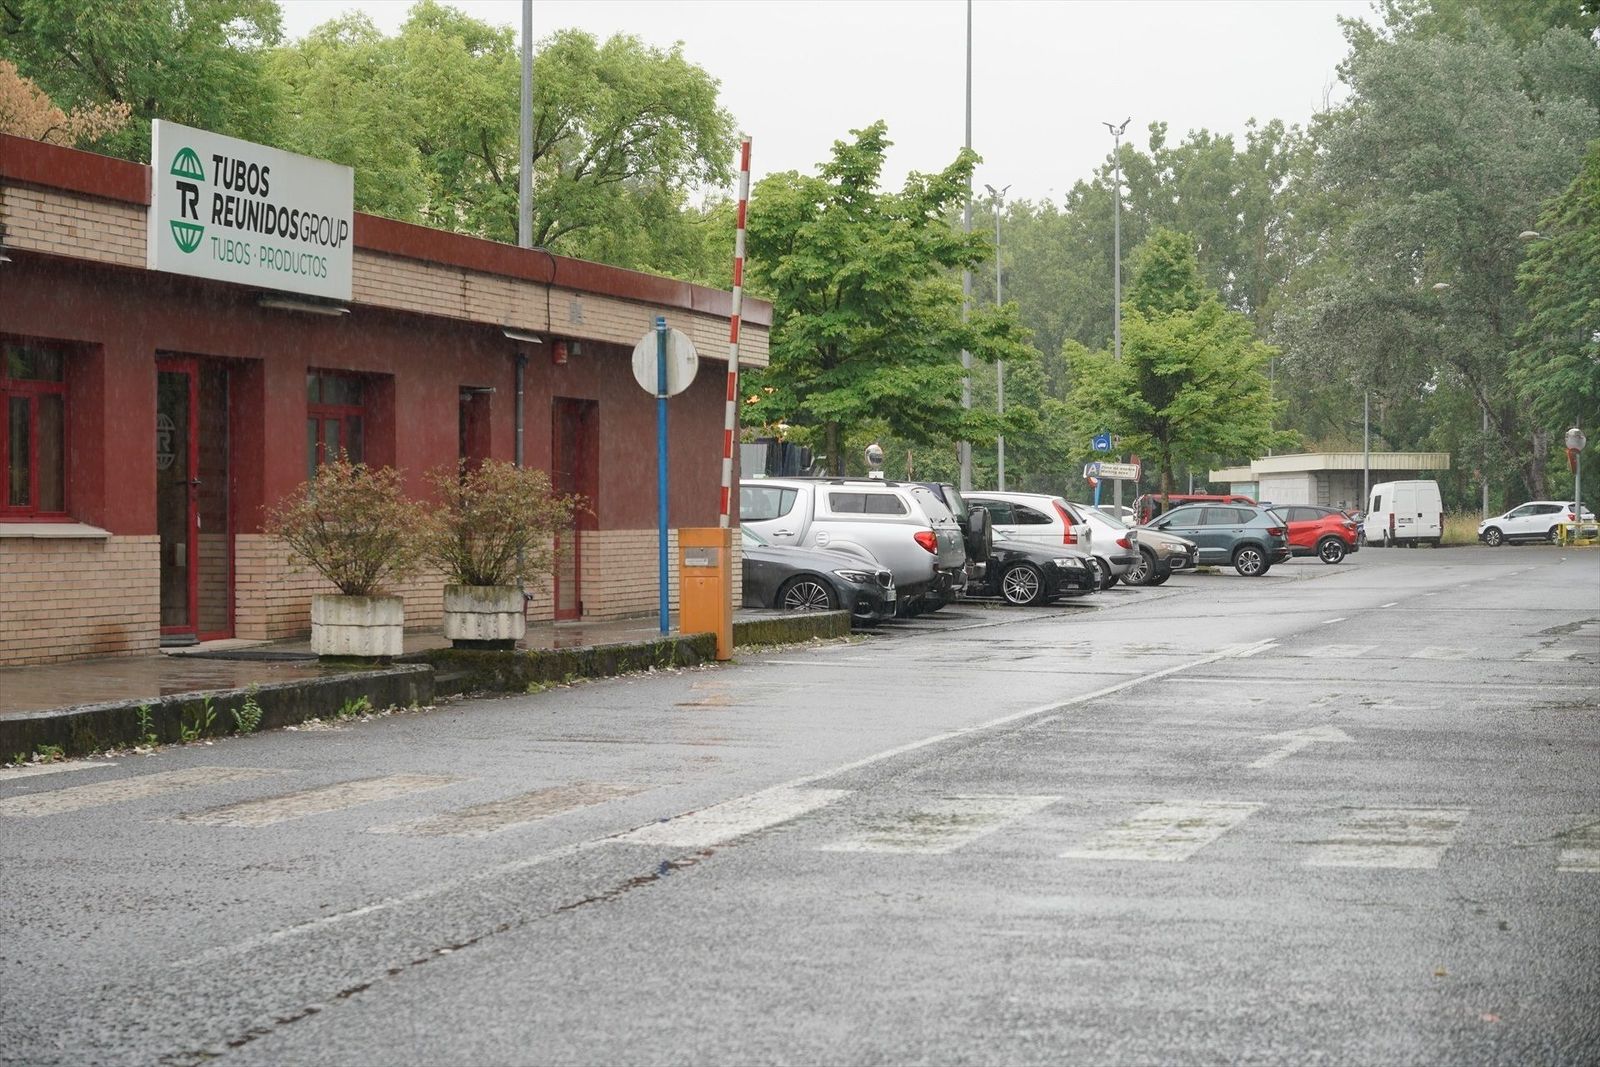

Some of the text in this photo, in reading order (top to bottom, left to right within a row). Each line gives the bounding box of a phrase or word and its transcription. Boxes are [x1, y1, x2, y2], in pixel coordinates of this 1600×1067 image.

[212, 153, 271, 198] TUBOS
[210, 236, 328, 279] TUBOS PRODUCTOS
